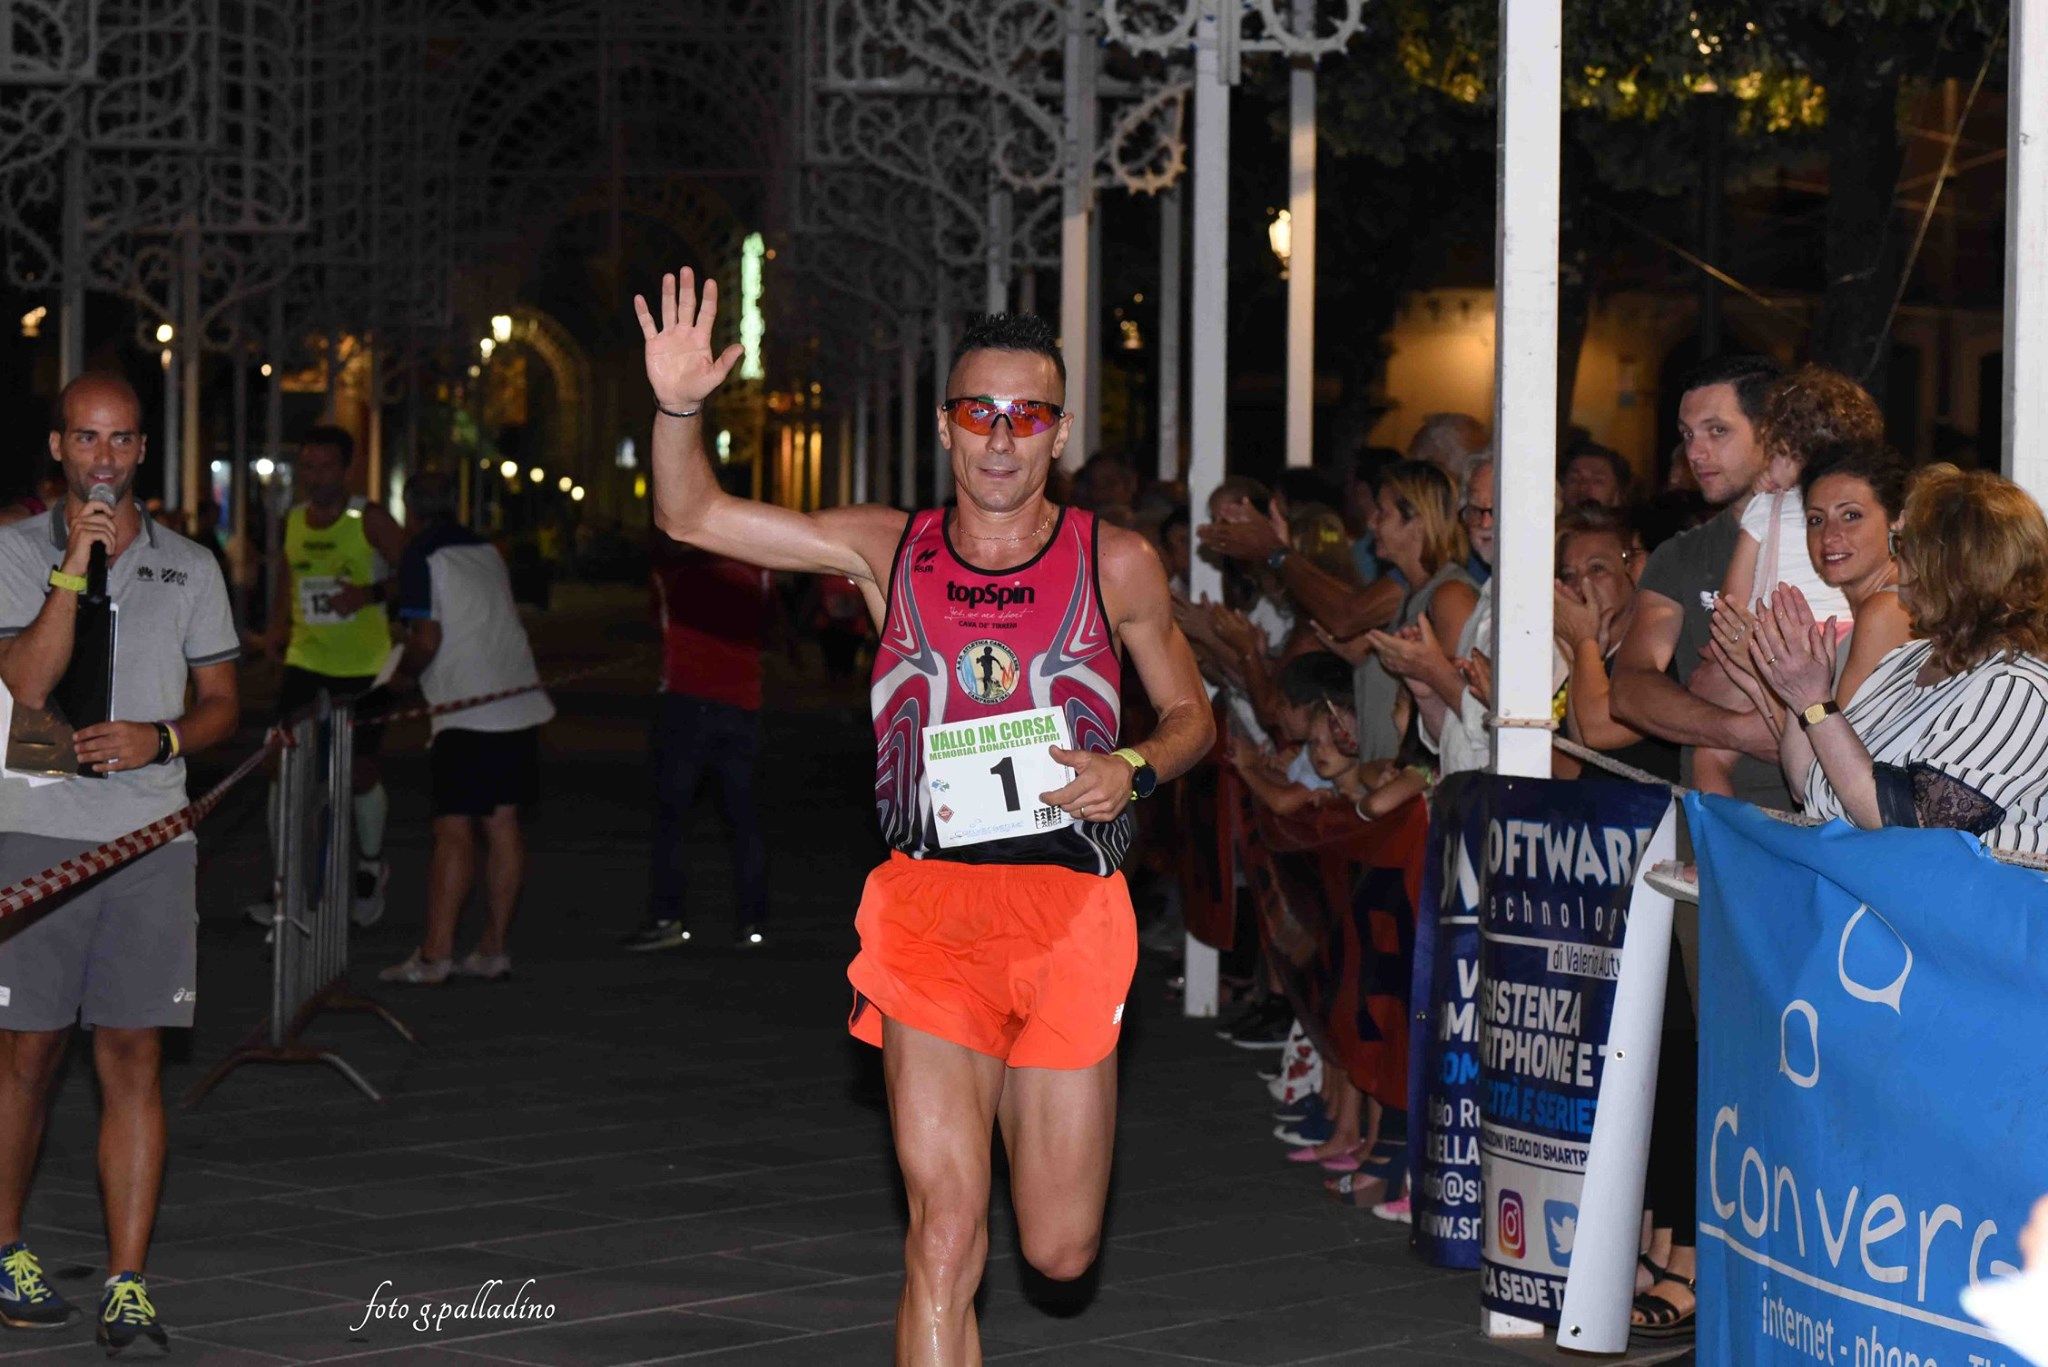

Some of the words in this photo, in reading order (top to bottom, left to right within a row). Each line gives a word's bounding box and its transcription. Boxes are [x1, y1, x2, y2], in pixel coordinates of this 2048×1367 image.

[946, 581, 1035, 610] topSpin
[929, 728, 976, 752] VALLO
[978, 725, 997, 744] IN
[999, 714, 1057, 741] CORSA
[929, 748, 977, 761] MEMORIAL
[980, 739, 1032, 753] DONATELLA
[1033, 732, 1061, 745] FERRI
[990, 756, 1020, 812] 1
[1576, 1042, 1594, 1087] E
[1534, 1089, 1598, 1135] SERIE
[1505, 1135, 1532, 1156] VELOCI
[1533, 1141, 1542, 1160] DI
[1543, 1144, 1588, 1167] SMARTP
[1499, 1270, 1550, 1309] SEDE
[1762, 1281, 1834, 1366] internet
